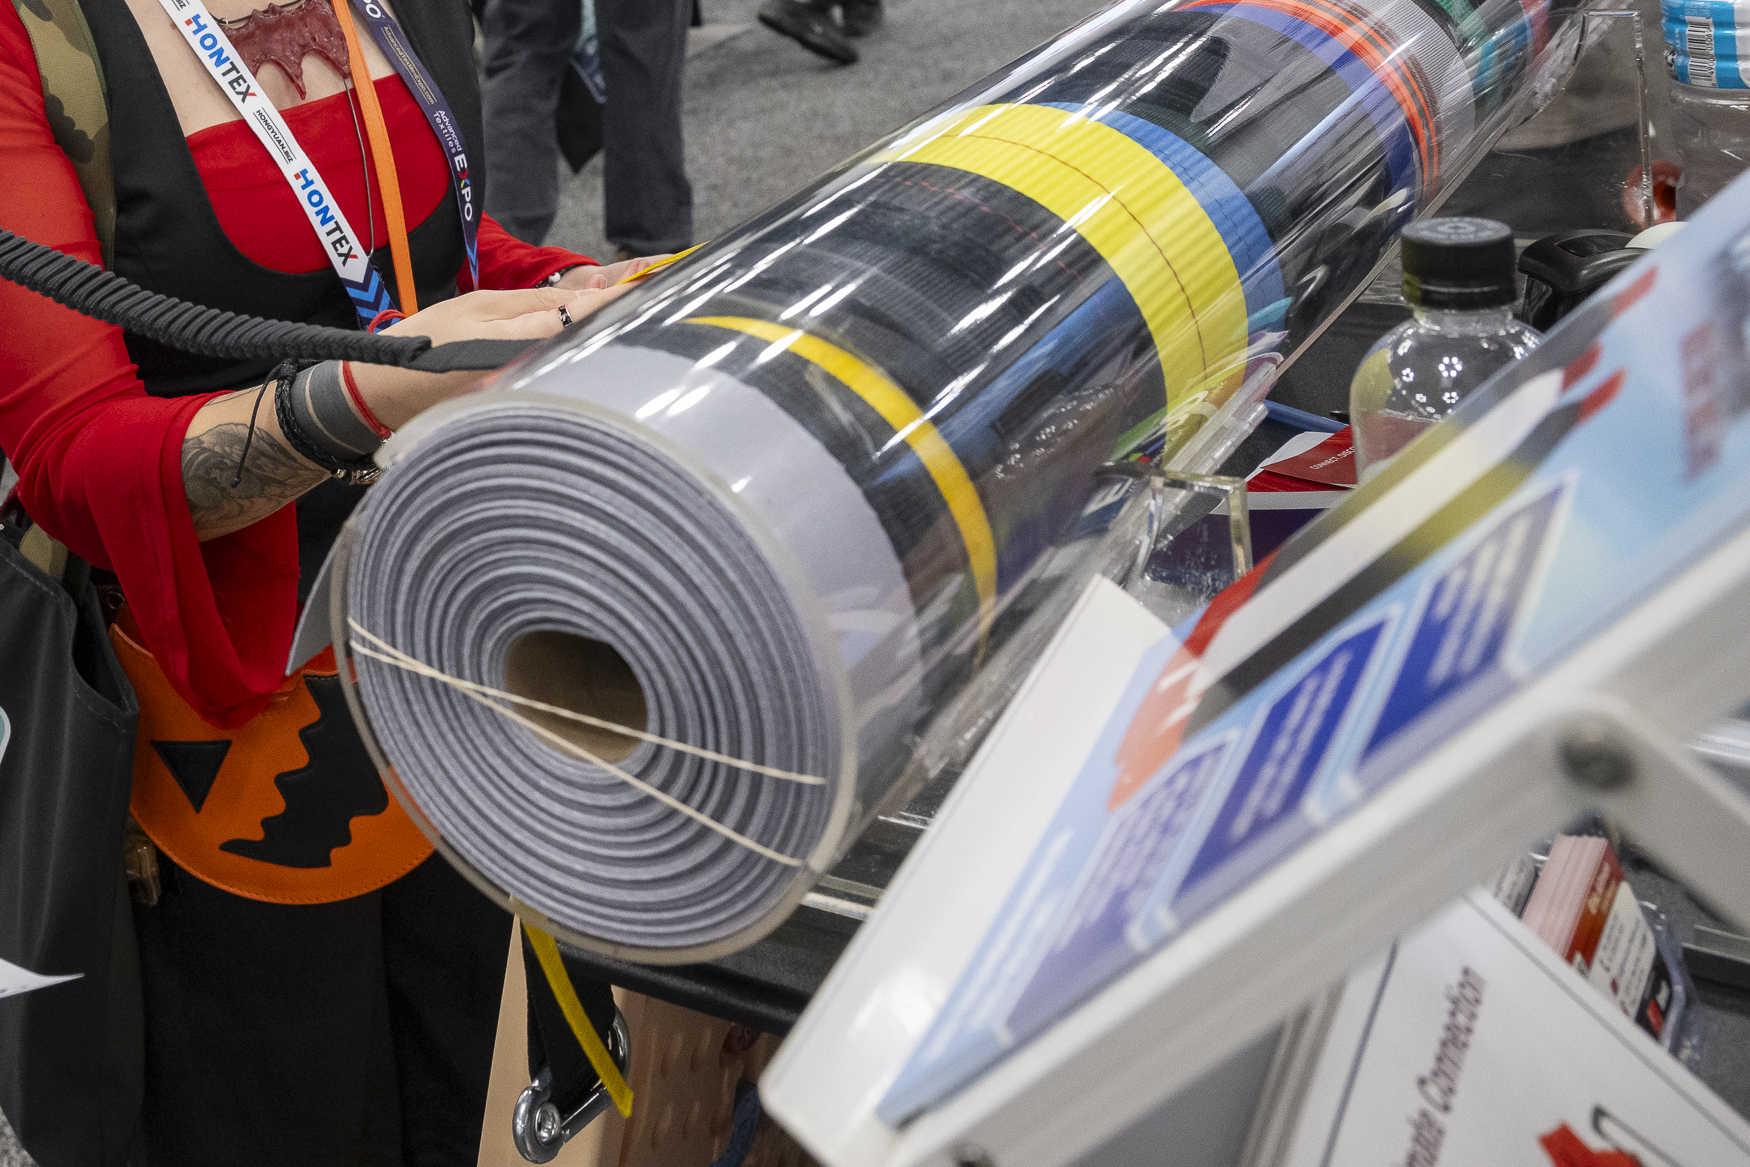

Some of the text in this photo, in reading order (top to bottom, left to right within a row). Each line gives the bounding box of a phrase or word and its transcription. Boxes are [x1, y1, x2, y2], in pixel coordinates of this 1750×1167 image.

[184, 13, 257, 103] HONTEX
[382, 25, 435, 106] AdvancedTextilesExpo.com
[256, 109, 294, 163] HONGYUAN.BIZ
[433, 111, 457, 154] Textiles
[438, 109, 463, 152] Advanced
[293, 168, 359, 267] HONTEX
[453, 152, 473, 222] EXPO
